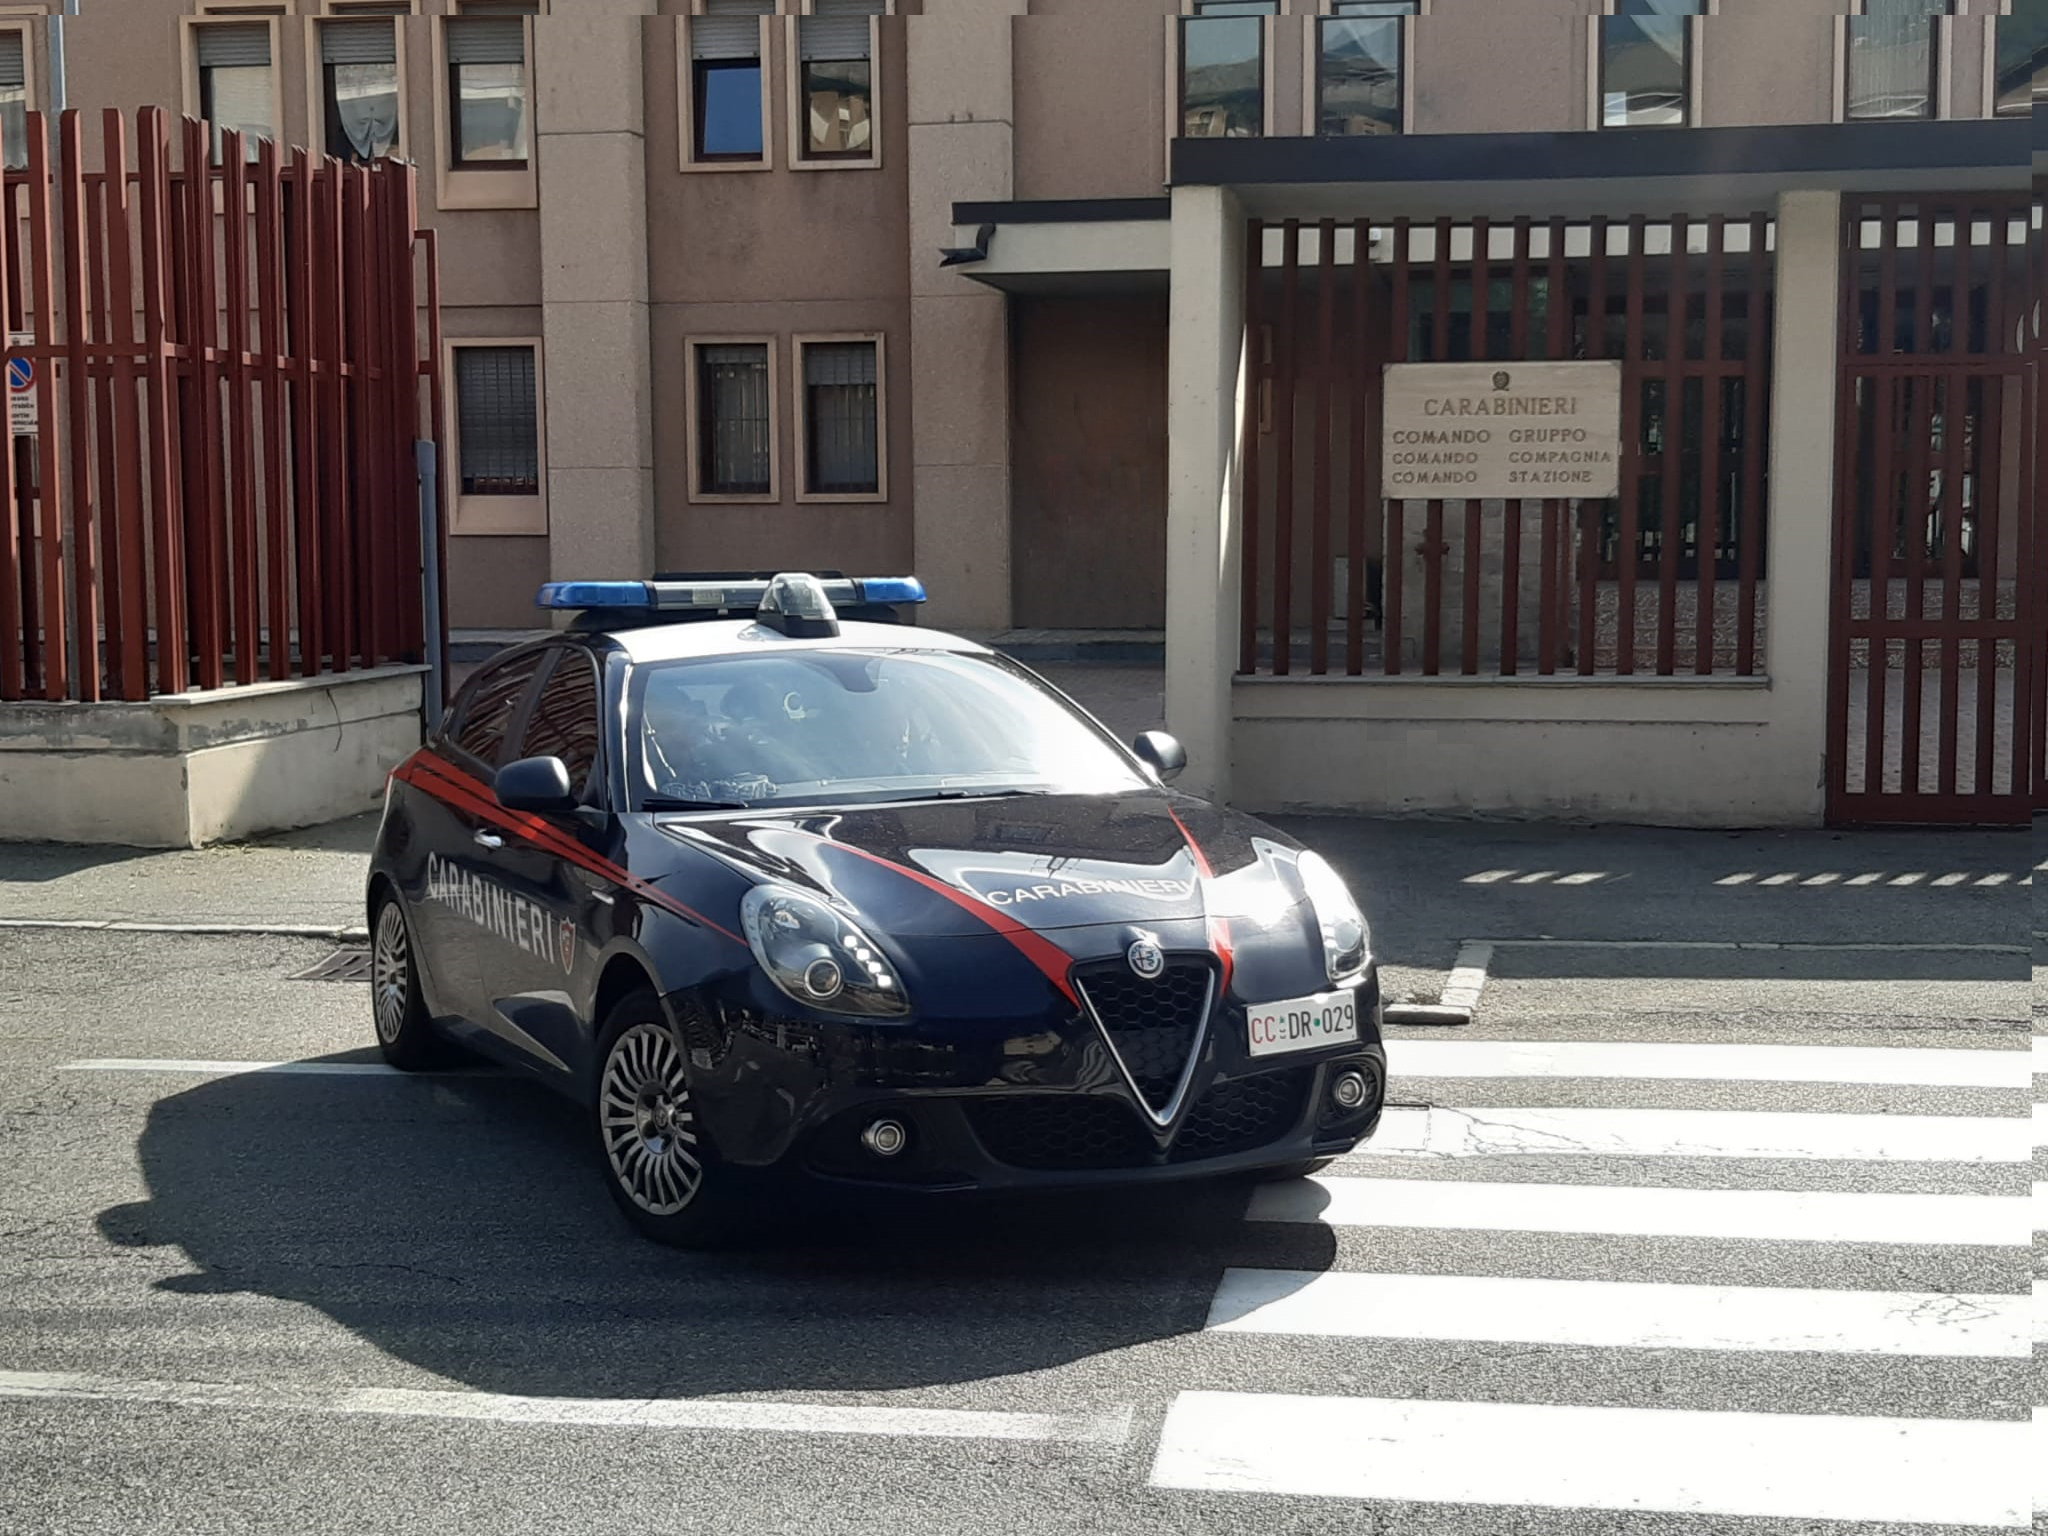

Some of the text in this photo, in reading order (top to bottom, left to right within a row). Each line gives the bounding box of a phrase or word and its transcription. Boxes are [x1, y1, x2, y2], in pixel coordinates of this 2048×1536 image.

[1424, 397, 1577, 416] CARABINIERI
[1392, 428, 1586, 445] COMANDO GRUPPO
[1392, 450, 1611, 465] COMANDO COMPAGNIA
[1392, 470, 1593, 484] COMANDO STAZIONE
[986, 878, 1194, 906] CARABINIERI
[427, 851, 554, 965] CARABINIERI
